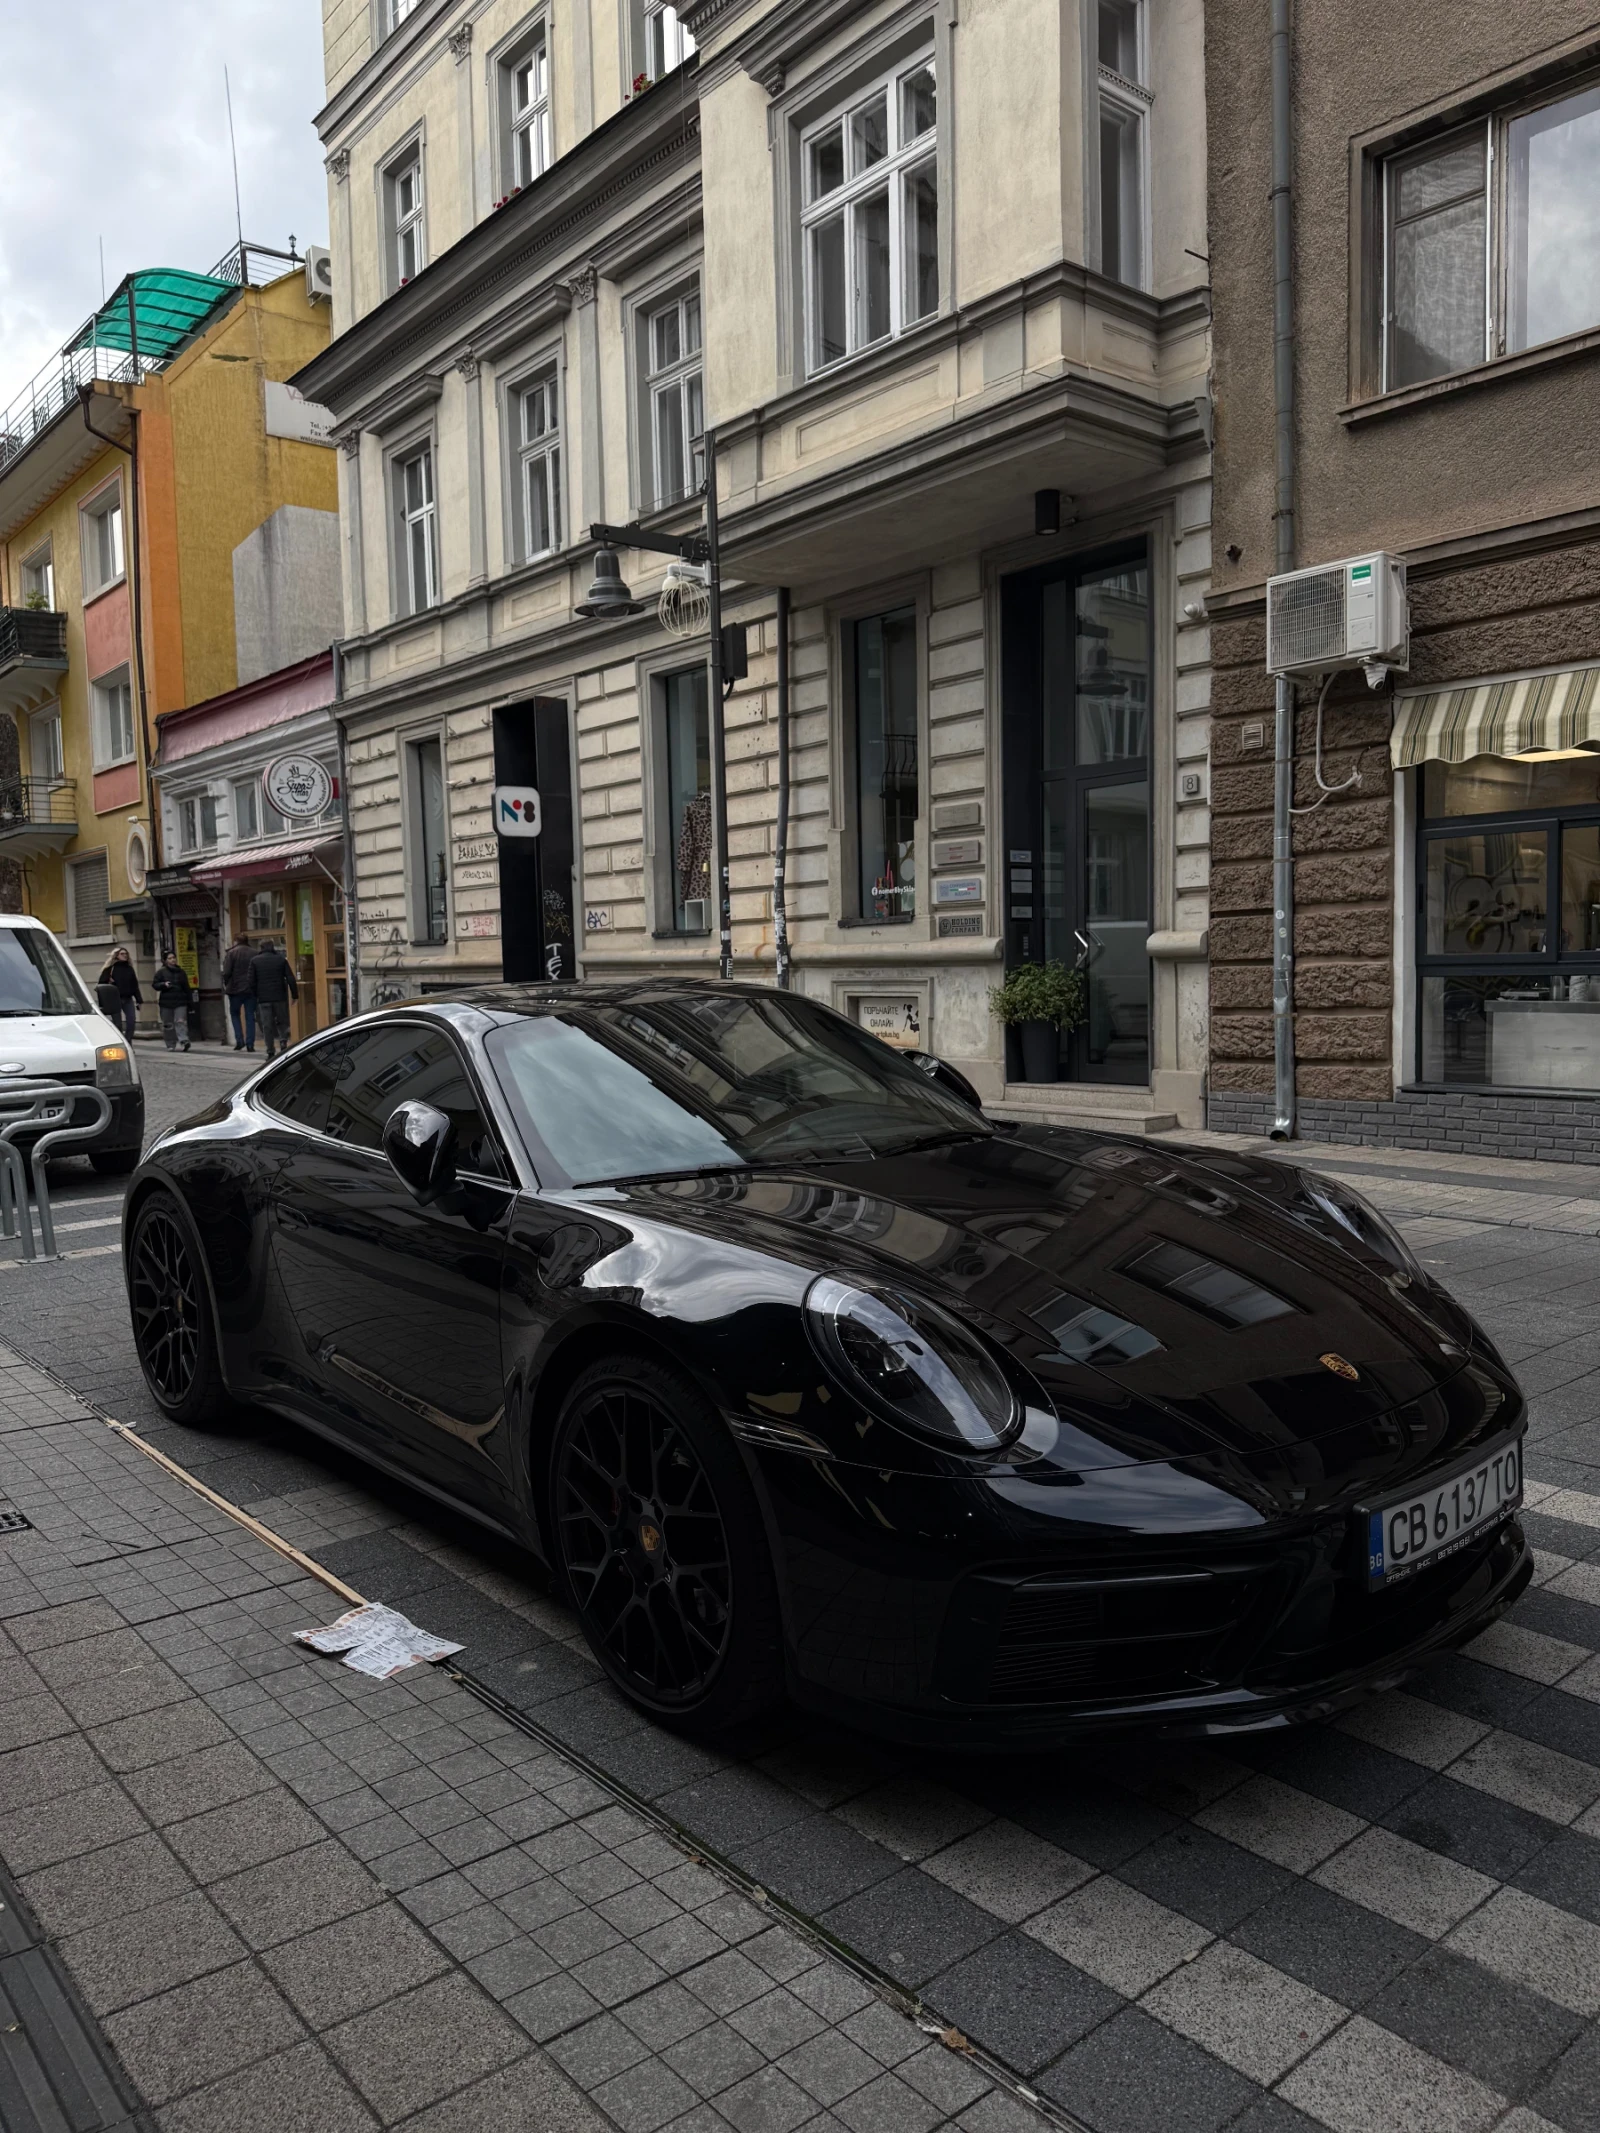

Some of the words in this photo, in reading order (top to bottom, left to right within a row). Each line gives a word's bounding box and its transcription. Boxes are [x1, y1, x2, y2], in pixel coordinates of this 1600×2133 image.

[310, 428, 322, 437] Fax
[1186, 777, 1194, 790] 8
[952, 917, 980, 925] HOLDING
[863, 1005, 899, 1016] ПОРЪЧАЙТЕ
[870, 1018, 894, 1028] ОНЛАЙН
[1389, 1502, 1428, 1561] CB
[1433, 1466, 1489, 1541] 6137
[1492, 1450, 1517, 1505] TO
[1369, 1552, 1382, 1570] BG
